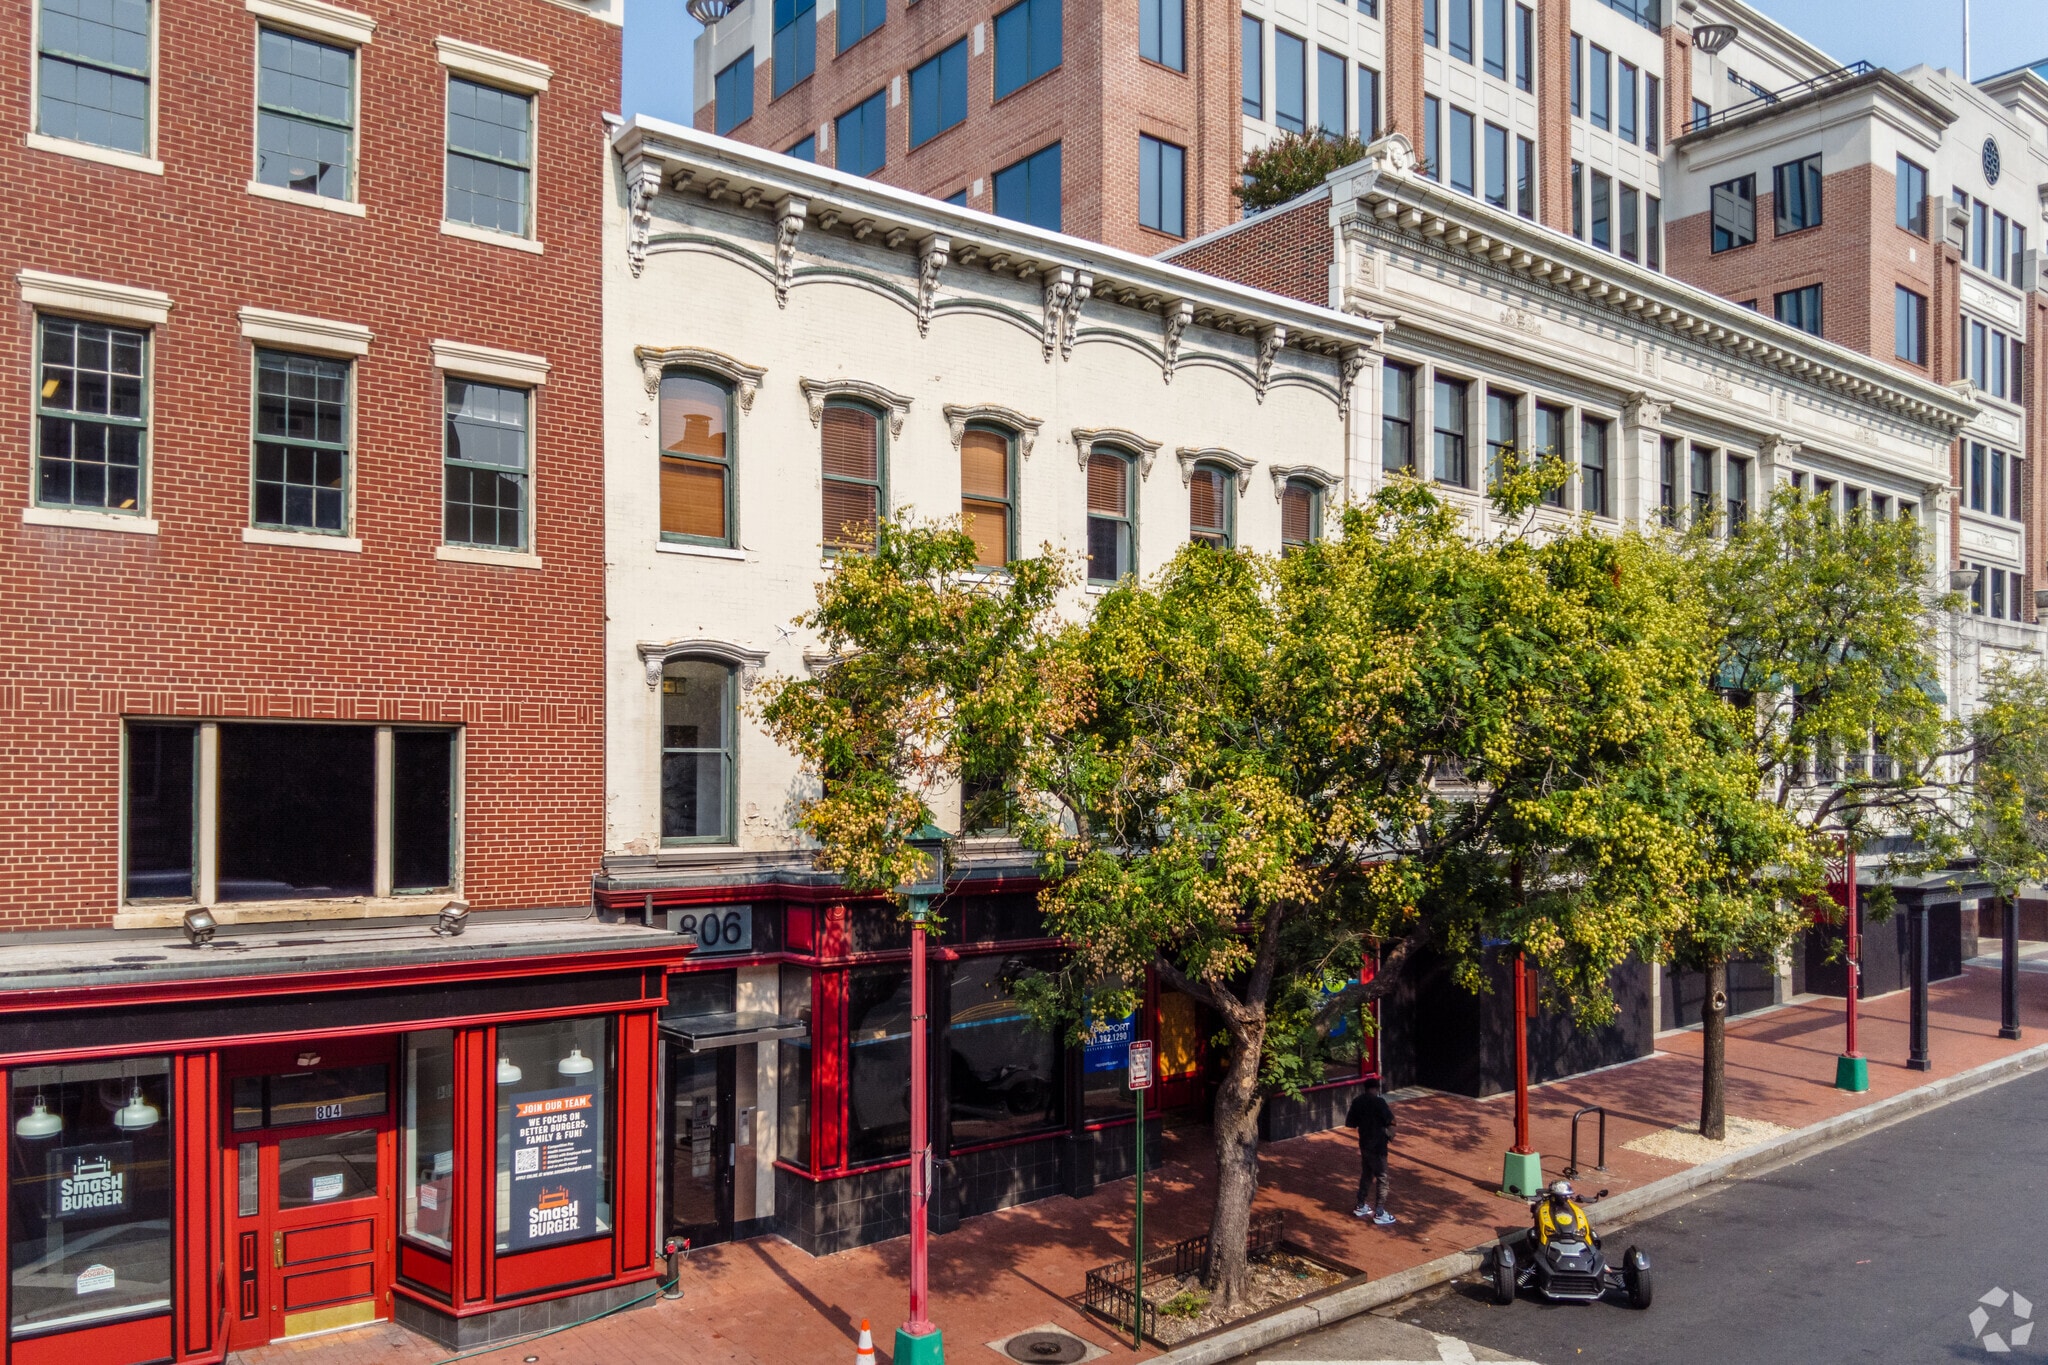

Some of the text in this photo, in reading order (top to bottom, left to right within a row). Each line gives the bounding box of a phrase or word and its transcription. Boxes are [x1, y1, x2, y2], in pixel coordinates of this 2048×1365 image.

[680, 912, 742, 946] 806
[317, 1104, 340, 1119] 804
[522, 1097, 586, 1114] JOIN OUR TEAM
[528, 1112, 580, 1126] WE FOCUS ON
[520, 1120, 588, 1137] BETTER BURGERS,
[526, 1128, 582, 1145] FAMILY & FUN!
[62, 1190, 122, 1212] BURGER
